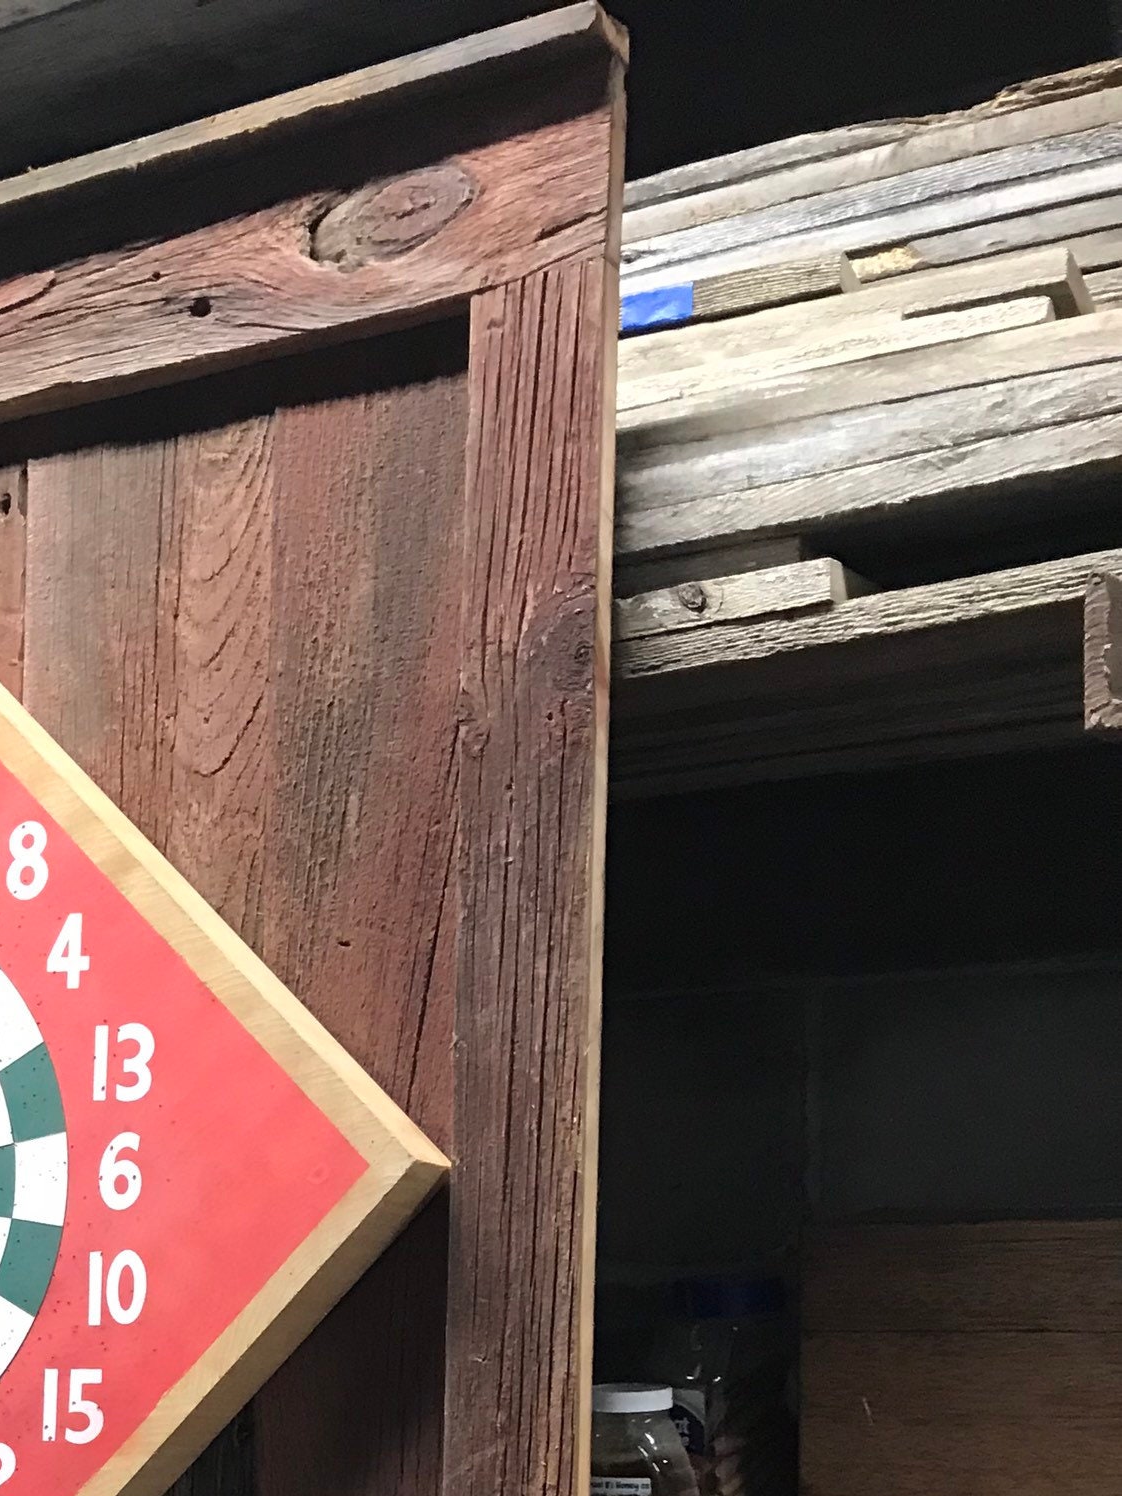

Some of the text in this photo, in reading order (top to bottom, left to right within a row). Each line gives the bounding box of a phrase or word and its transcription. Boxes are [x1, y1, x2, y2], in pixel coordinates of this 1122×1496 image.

[45, 912, 91, 990] 4
[92, 1022, 156, 1103] 13
[98, 1131, 143, 1211] 6
[87, 1248, 148, 1327] 10
[41, 1367, 105, 1445] 15
